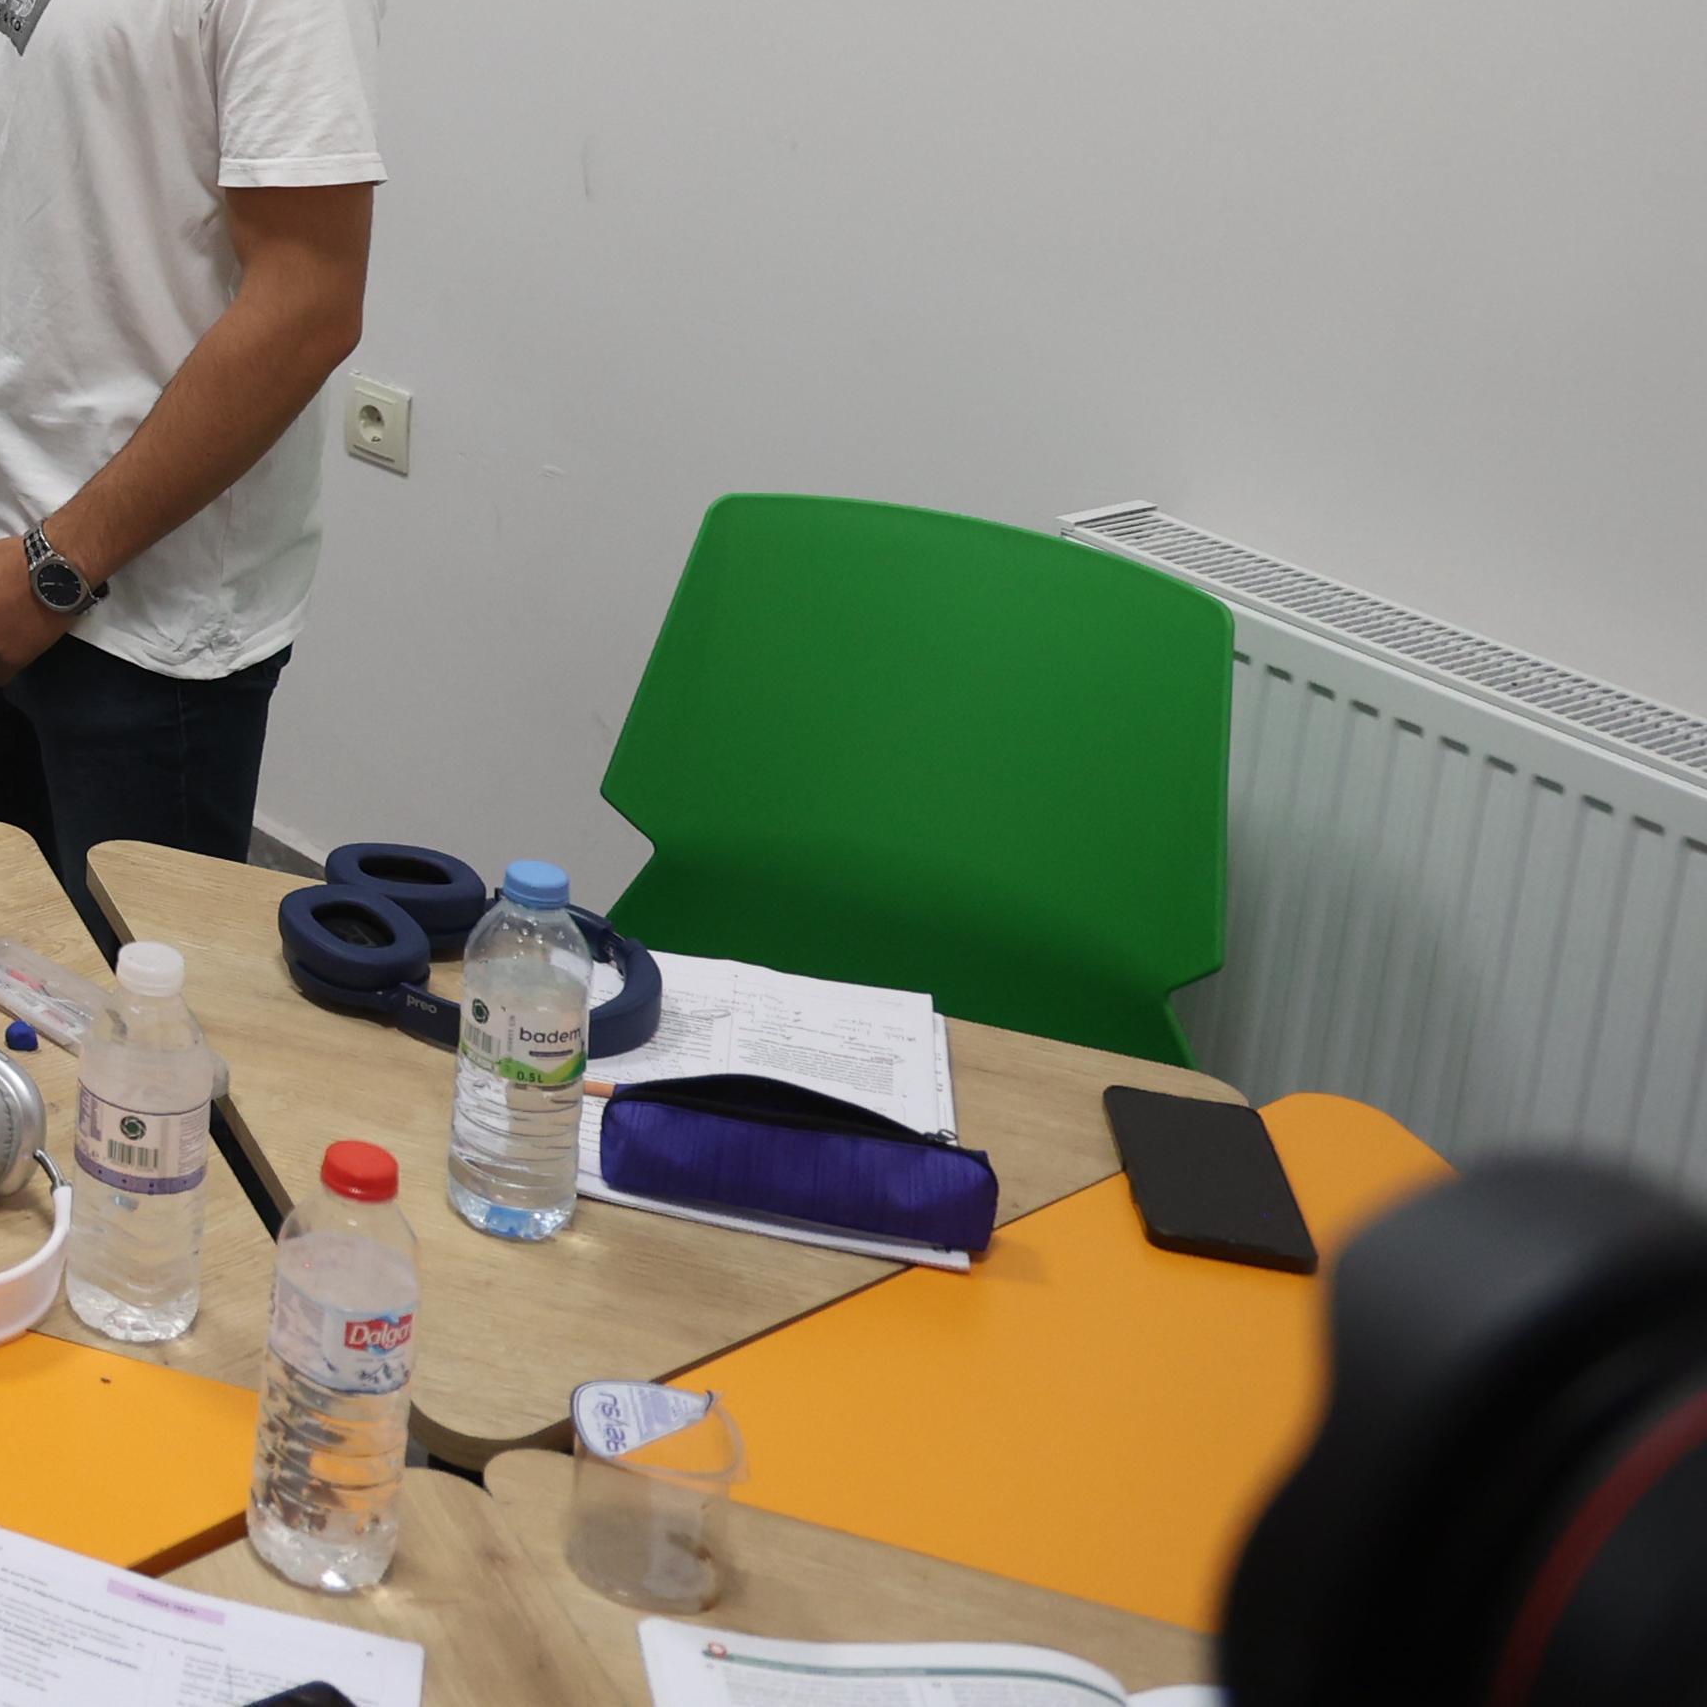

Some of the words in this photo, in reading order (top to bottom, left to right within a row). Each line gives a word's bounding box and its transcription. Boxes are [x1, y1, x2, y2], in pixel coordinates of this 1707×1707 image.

[406, 993, 437, 1015] preo
[519, 1027, 581, 1044] badem
[349, 1323, 410, 1350] Dalga
